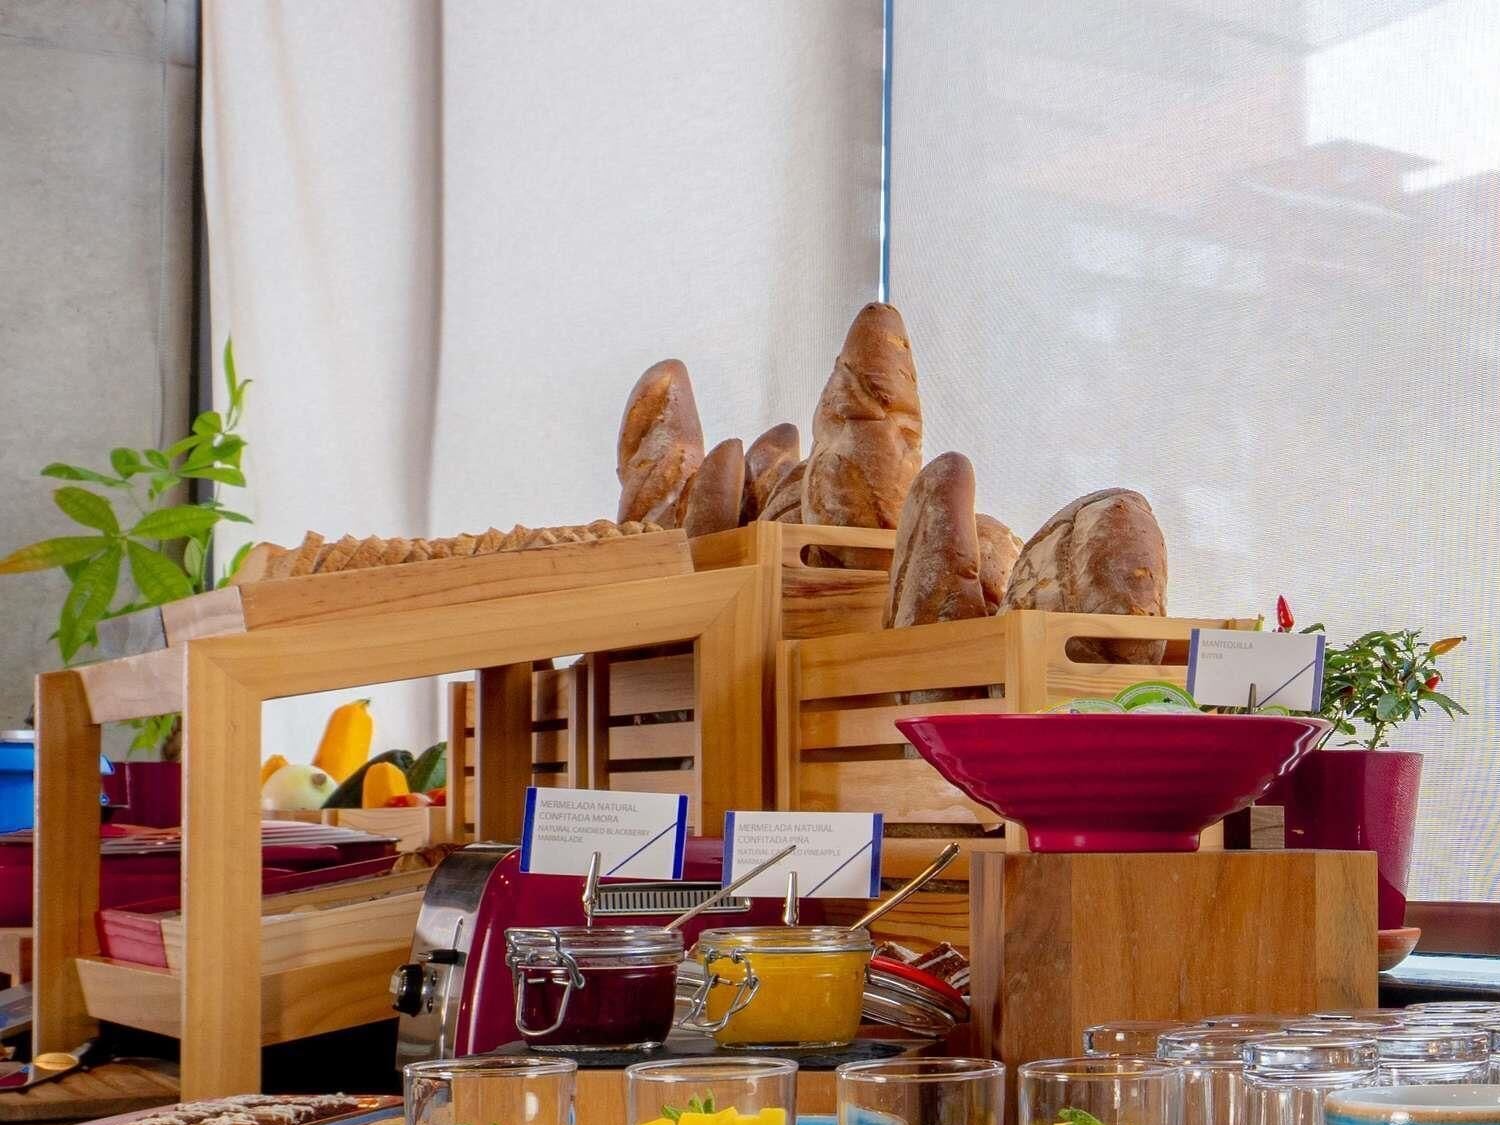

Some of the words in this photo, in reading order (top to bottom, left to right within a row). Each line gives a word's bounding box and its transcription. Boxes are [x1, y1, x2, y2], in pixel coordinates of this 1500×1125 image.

[540, 800, 597, 810] MERMELADA
[598, 802, 639, 812] NATURAL
[539, 812, 590, 822] CONFITADA
[592, 814, 619, 823] MORA
[738, 824, 792, 832] MERMELADA
[794, 824, 833, 832] NATURAL
[737, 835, 787, 844] CONFITADA
